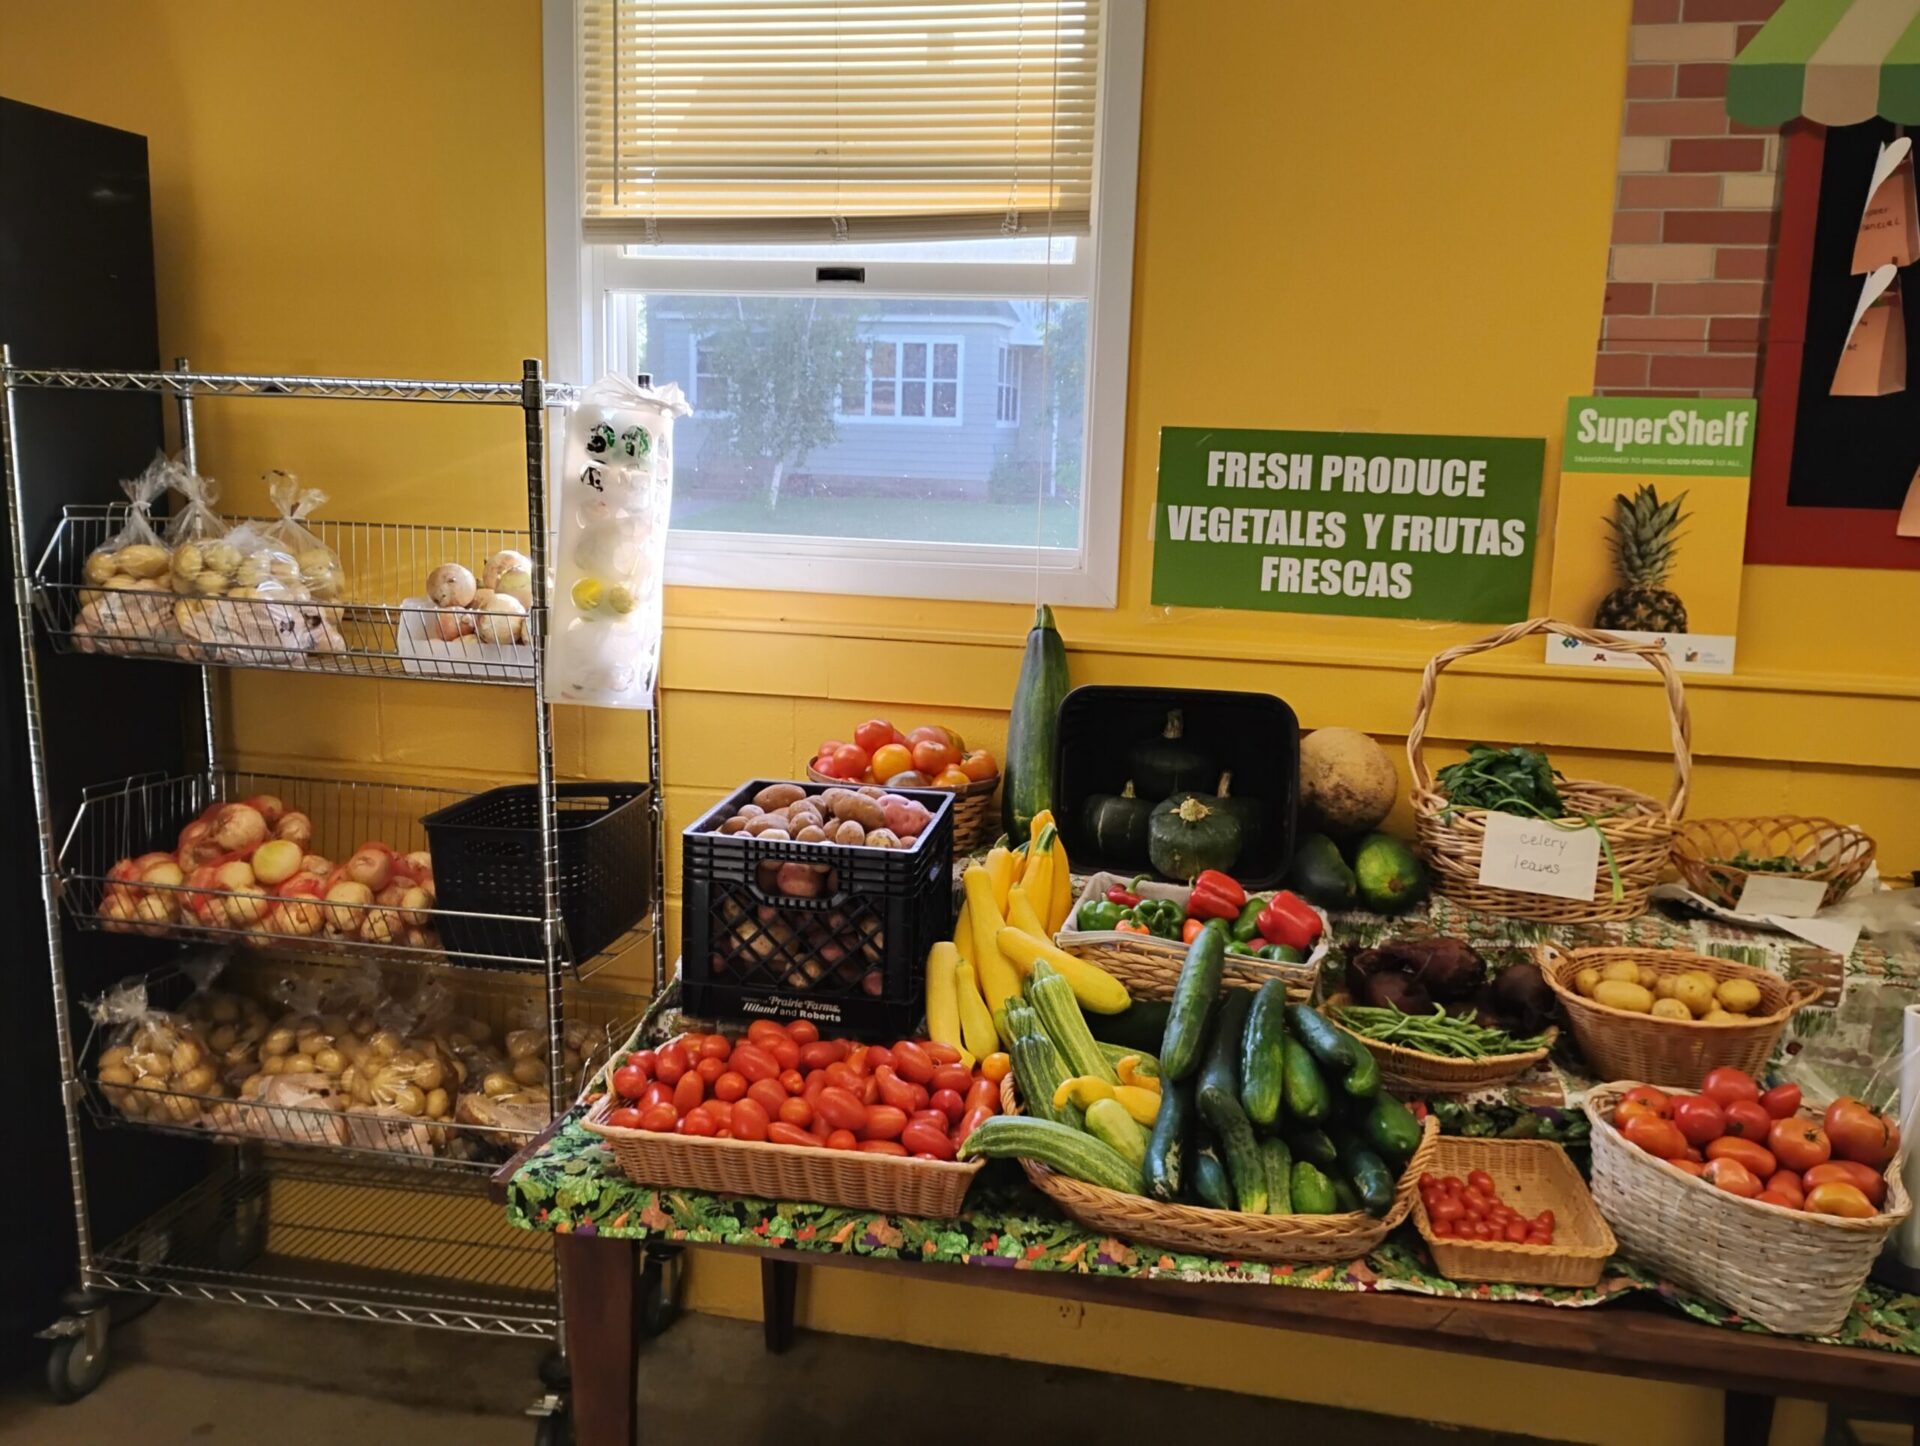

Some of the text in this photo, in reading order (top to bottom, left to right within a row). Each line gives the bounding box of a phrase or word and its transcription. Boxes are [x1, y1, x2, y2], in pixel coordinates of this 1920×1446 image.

[1577, 408, 1750, 452] SuperShelf
[1207, 451, 1487, 497] FRESH PRODUCE
[1167, 505, 1526, 557] VEGETALES Y FRUTAS
[1260, 556, 1413, 600] FRESCAS
[1514, 854, 1561, 875] leaves
[743, 1002, 842, 1023] Hiland and Roberts
[768, 995, 804, 1009] Prairie
